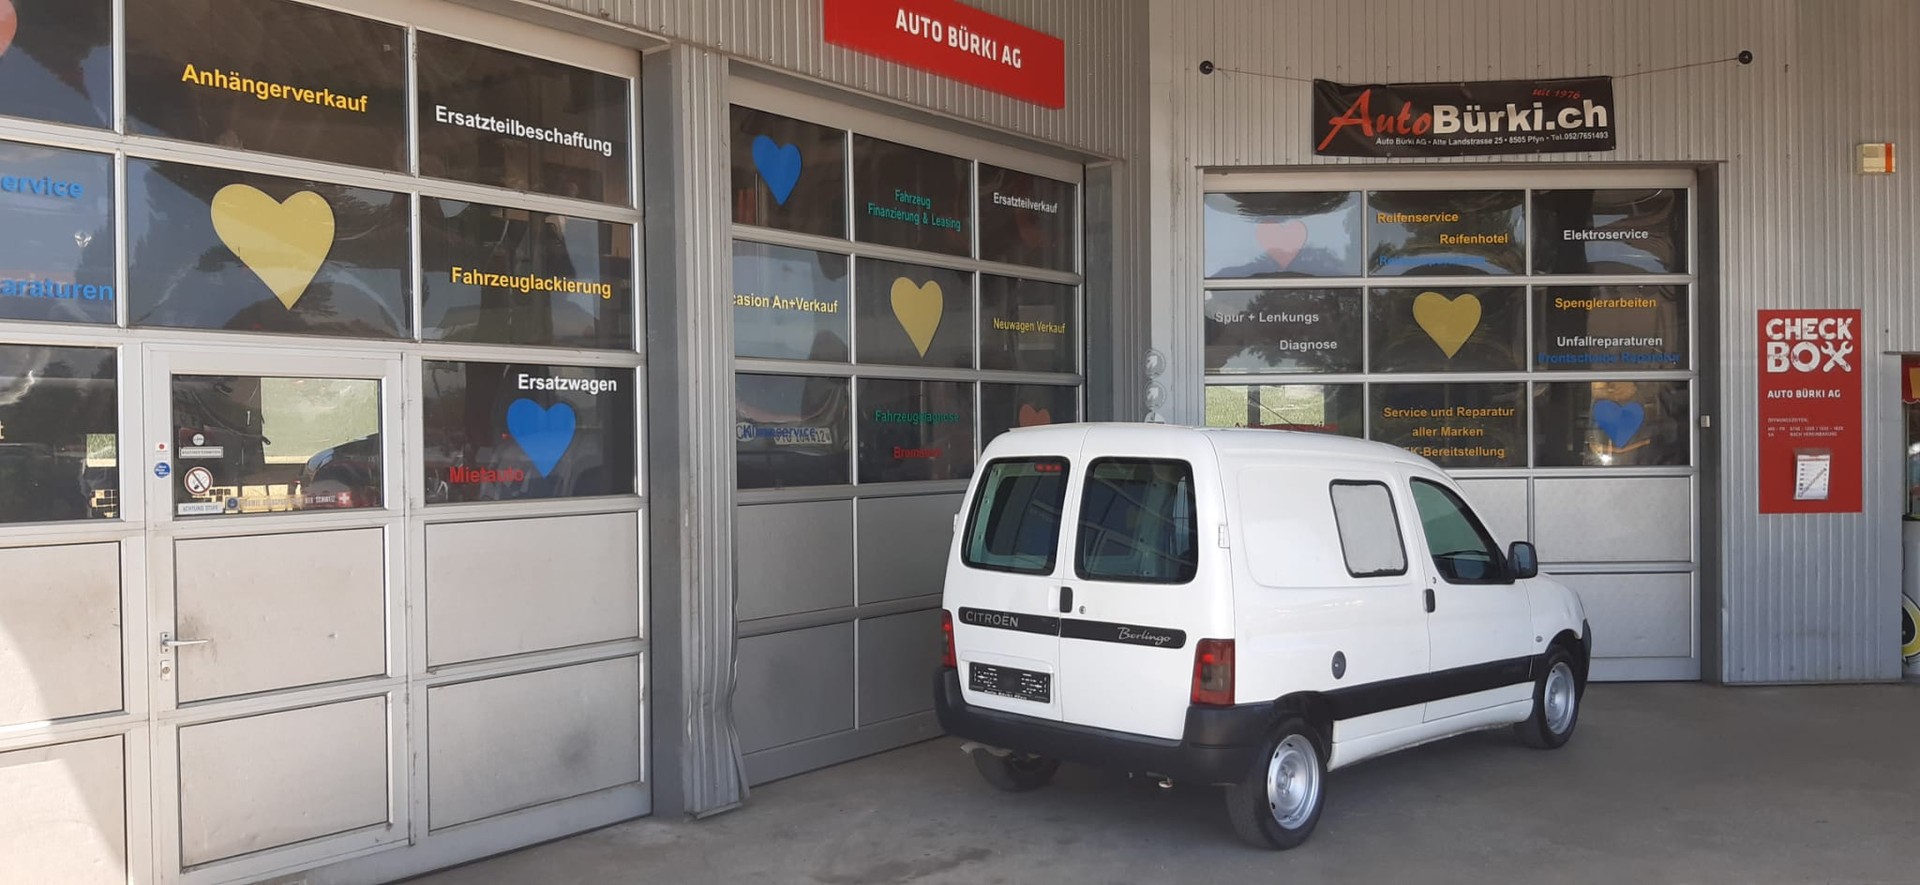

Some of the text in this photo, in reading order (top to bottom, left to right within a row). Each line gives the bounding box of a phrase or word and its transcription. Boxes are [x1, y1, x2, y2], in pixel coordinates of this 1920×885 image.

[896, 8, 1021, 69] AUTO BÜRKI AG
[181, 63, 368, 112] Anhängerverkauf
[435, 104, 613, 157] Ersatzteilbeschaffung
[1448, 137, 1493, 146] Landstrasse
[1494, 137, 1503, 145] 25
[1528, 135, 1545, 145] Pfyn
[895, 189, 931, 210] Fahrzeug
[993, 192, 1058, 214] Ersatzteilverkauf
[868, 203, 961, 232] Finanzierung & Leasing
[1377, 212, 1459, 224] Reifenservice
[1440, 233, 1508, 245] Reifenhotel
[1563, 228, 1649, 242] Elektroservice
[452, 266, 612, 299] Fahrzeuglackierung
[772, 295, 838, 313] An+Verkauf
[1555, 297, 1657, 310] Spenglerarbeiten
[993, 317, 1066, 334] Neuwagen Verkauf
[1215, 311, 1320, 324] Spur + Lenkungs
[1766, 318, 1853, 340] CHECK
[1280, 340, 1338, 352] Diagnose
[1556, 336, 1663, 349] Unfallreparaturen
[518, 374, 617, 395] Ersatzwagen
[1767, 388, 1841, 399] AUTO BÜRKI AG
[1384, 406, 1515, 419] Service und Reparatur
[1412, 427, 1484, 437] aller Marken
[450, 466, 525, 484] Mietauto
[965, 610, 1020, 628] CITROËN
[1117, 626, 1171, 646] Berlingo
